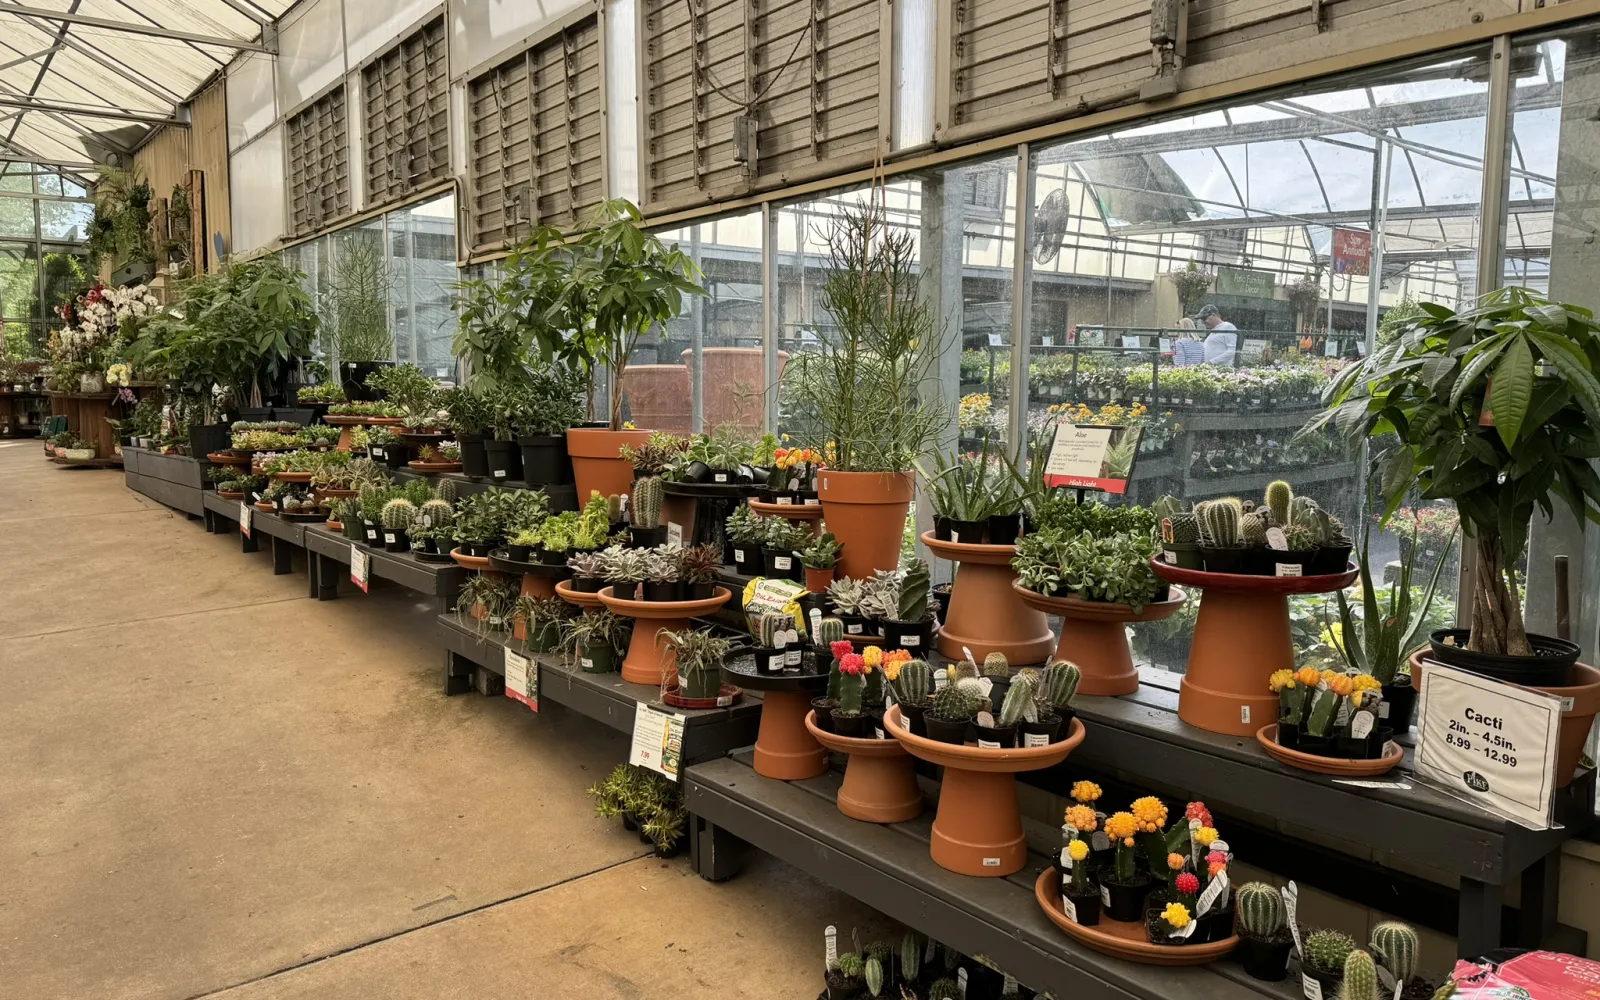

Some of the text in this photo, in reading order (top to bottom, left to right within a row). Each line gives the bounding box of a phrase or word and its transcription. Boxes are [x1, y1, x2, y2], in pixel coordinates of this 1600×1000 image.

[1342, 243, 1366, 257] Annuals
[1069, 479, 1082, 487] High
[1464, 707, 1503, 731] Cacti
[1448, 719, 1470, 735] 2in.
[1482, 731, 1517, 752] 4.5in.
[1446, 733, 1471, 750] 8.99
[1484, 747, 1518, 768] 12.99
